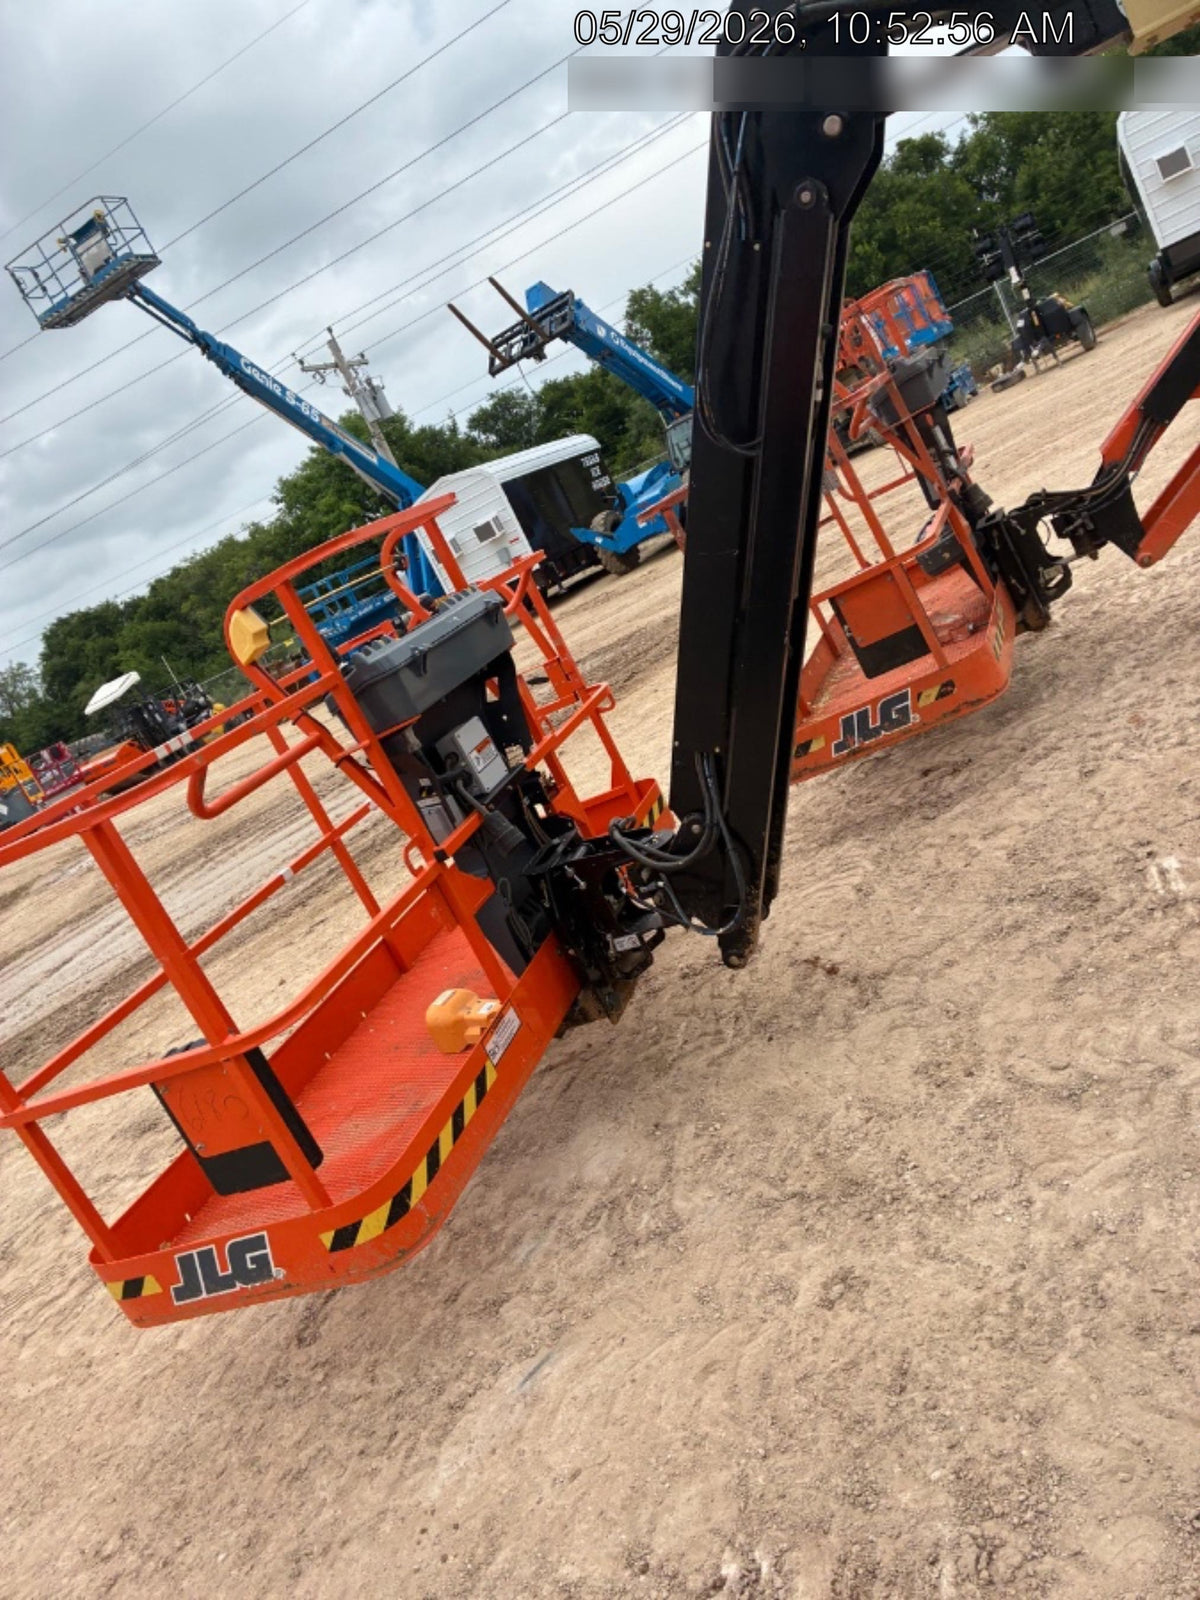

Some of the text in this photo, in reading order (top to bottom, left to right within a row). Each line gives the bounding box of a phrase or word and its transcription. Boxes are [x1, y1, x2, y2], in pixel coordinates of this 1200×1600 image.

[240, 356, 282, 396] Genie
[831, 687, 913, 758] JLG
[170, 1230, 276, 1305] JLG
